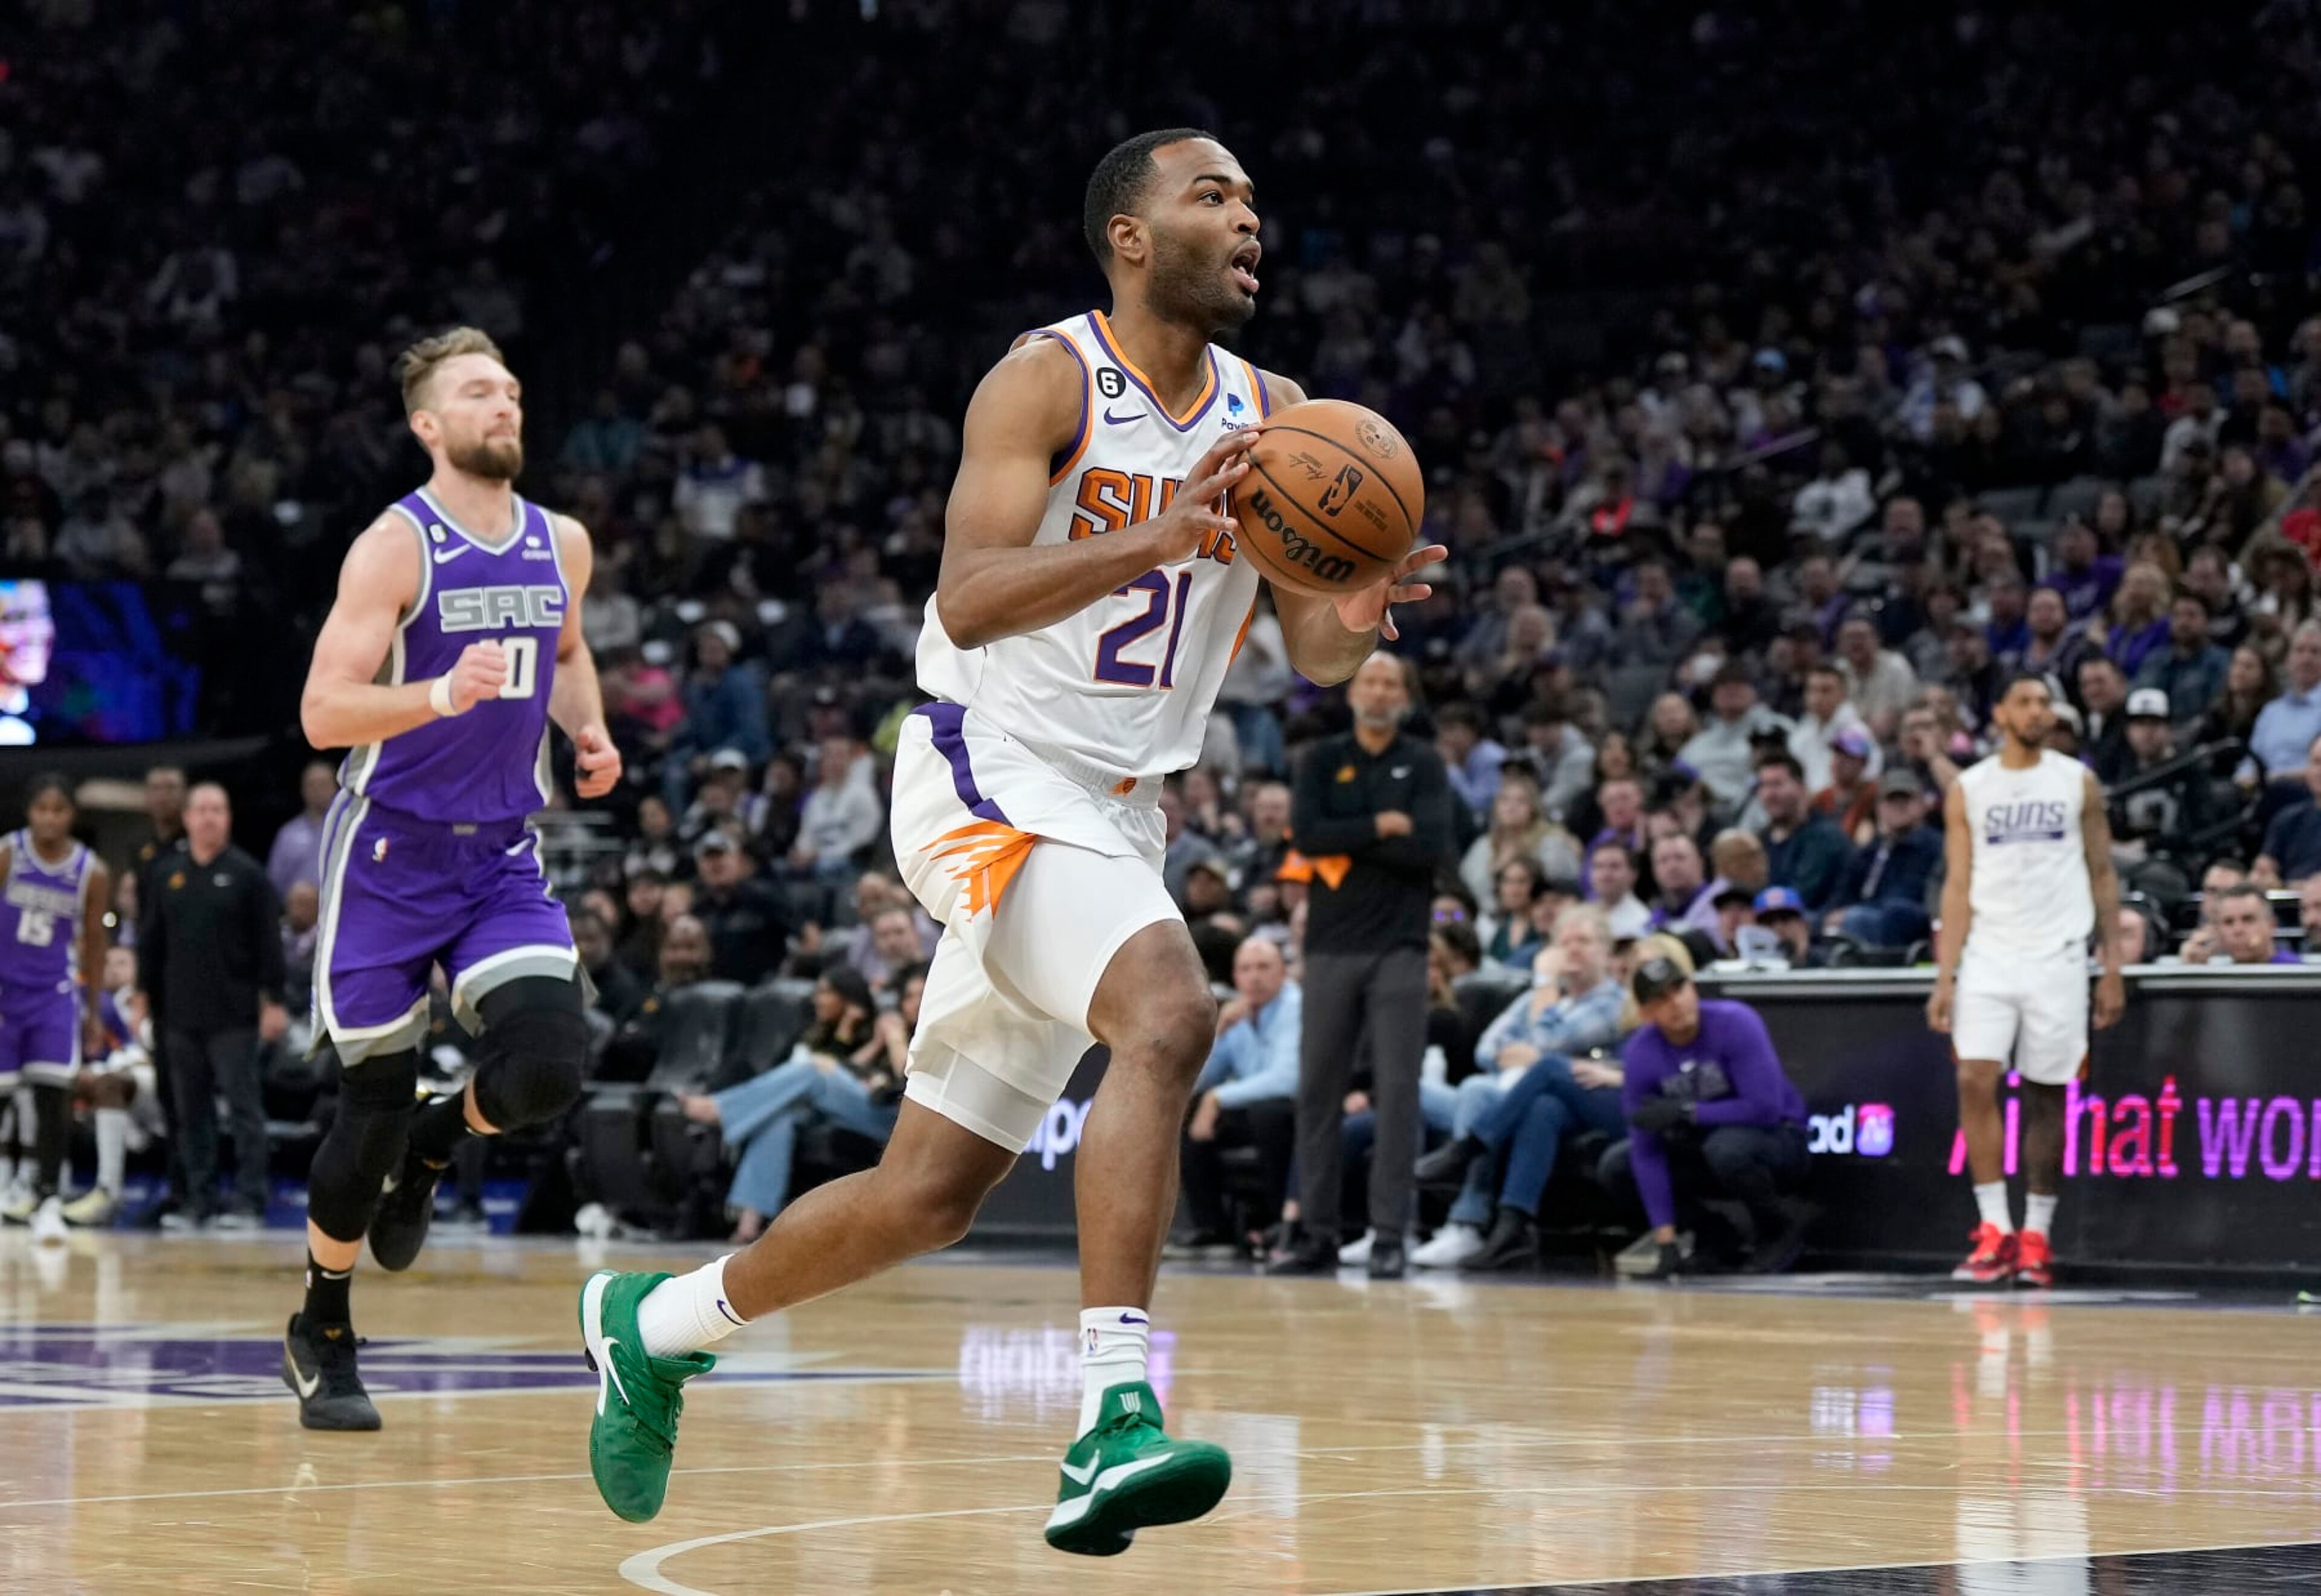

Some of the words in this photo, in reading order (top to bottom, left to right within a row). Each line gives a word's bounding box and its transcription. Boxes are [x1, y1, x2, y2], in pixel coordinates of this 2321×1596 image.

[1101, 372, 1119, 395] 6
[1069, 466, 1237, 566] SU
[1251, 486, 1356, 583] Wilson
[438, 584, 563, 633] SAC
[1093, 566, 1193, 691] 21
[479, 636, 538, 699] 0
[17, 908, 53, 947] 15
[2062, 1077, 2183, 1177] hat
